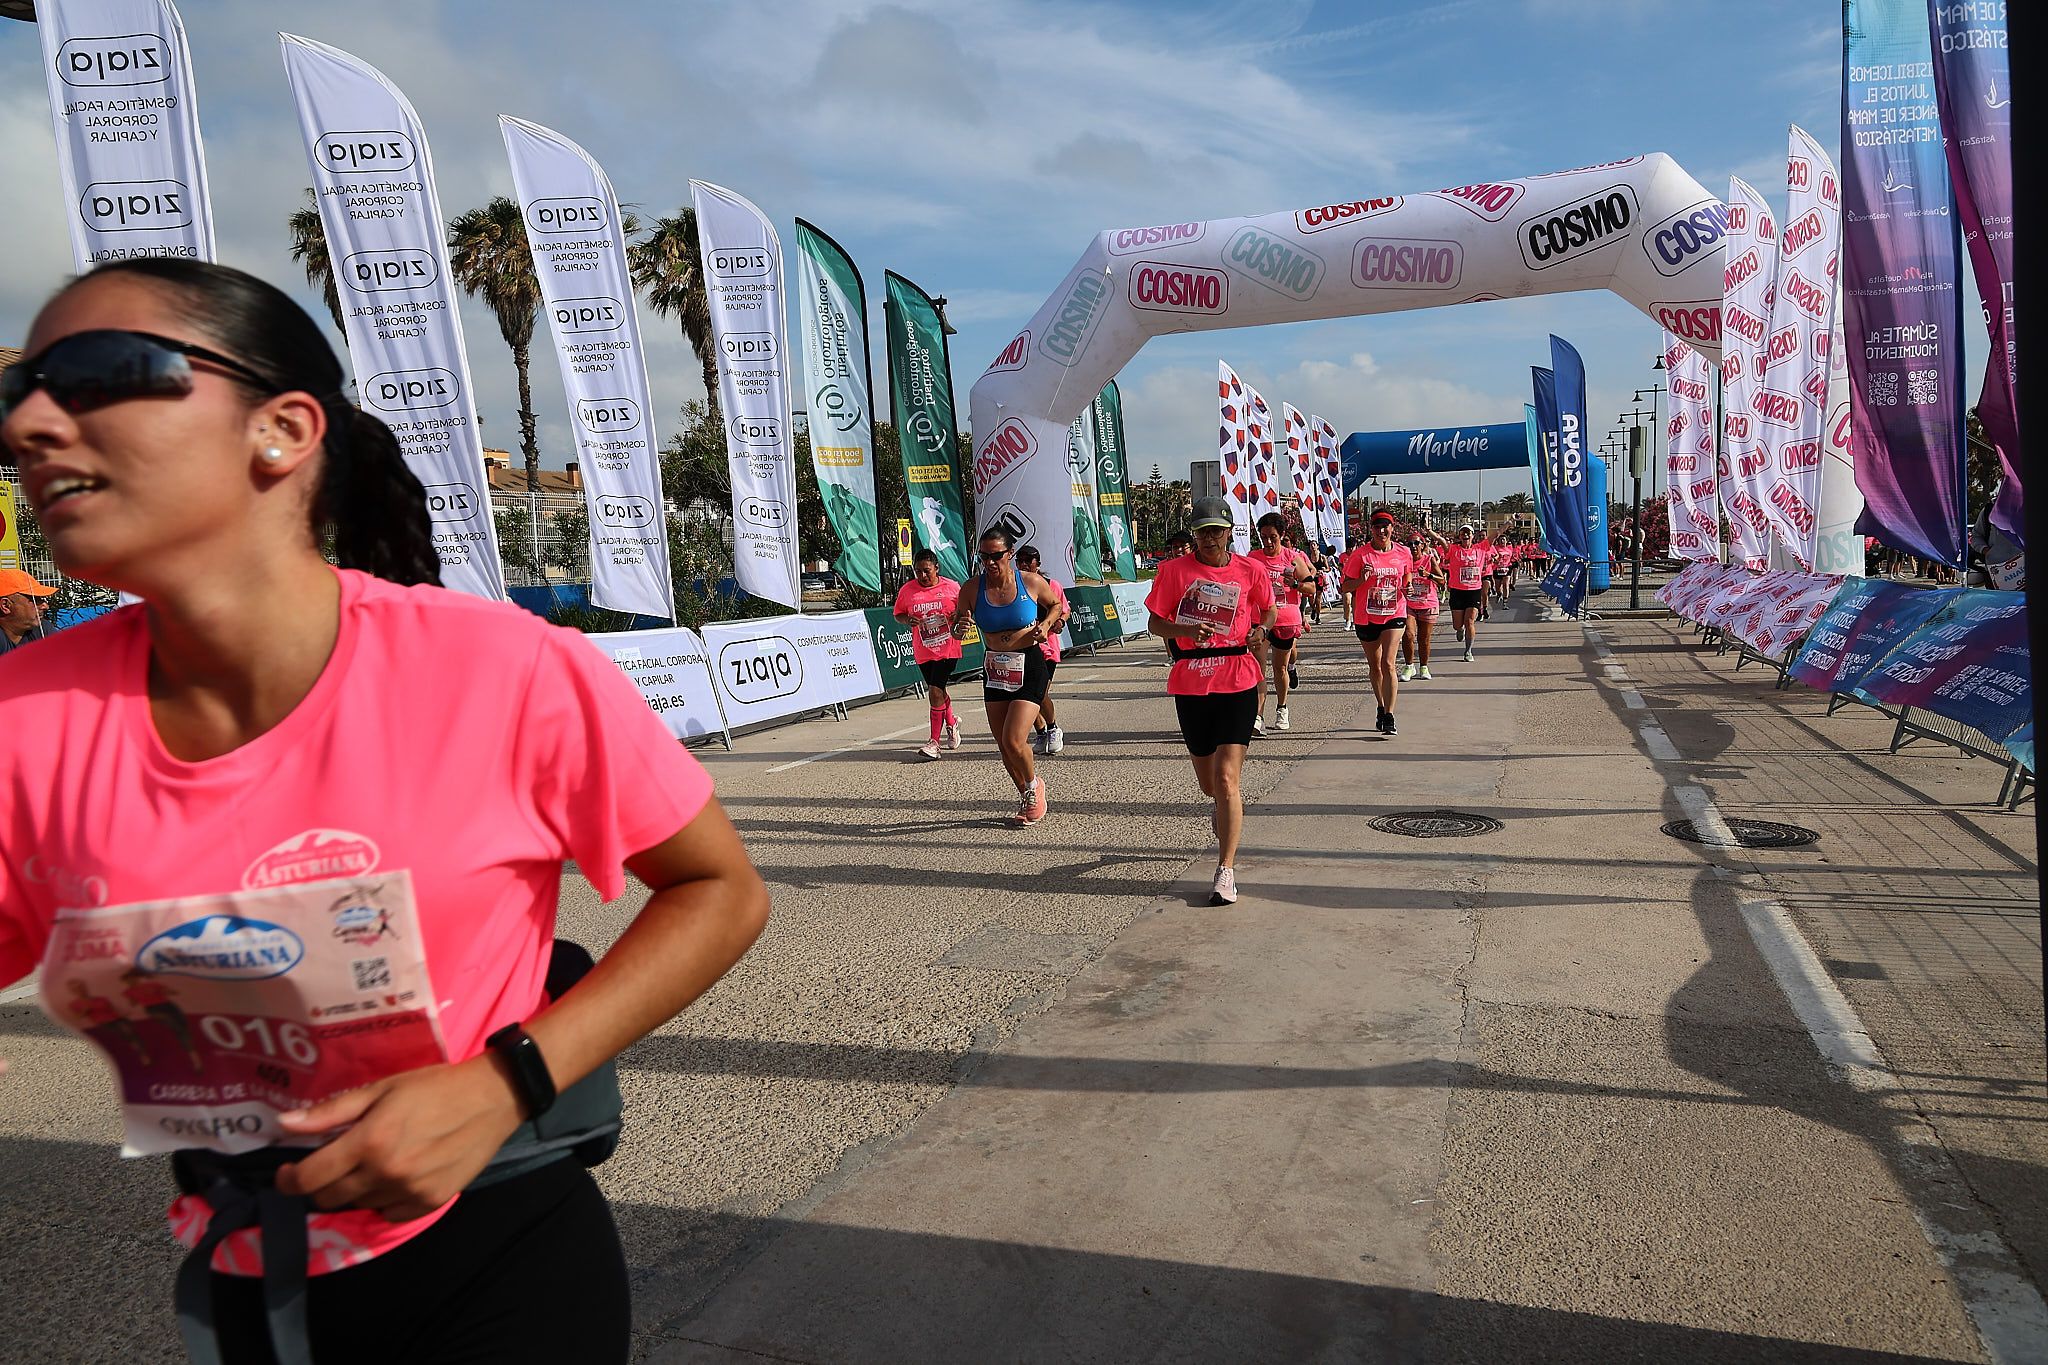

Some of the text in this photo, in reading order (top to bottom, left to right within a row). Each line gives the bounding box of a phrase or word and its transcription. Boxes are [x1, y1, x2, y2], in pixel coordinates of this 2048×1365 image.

[1116, 222, 1199, 249] COSMO
[1528, 192, 1631, 261] COSMO
[1655, 202, 1730, 266] COSM
[1231, 231, 1317, 294] COSMO
[1360, 244, 1454, 284] COSMO
[1137, 268, 1221, 309] COSMO
[1046, 276, 1106, 357] COSMO
[1659, 307, 1723, 341] COSM
[975, 426, 1029, 495] COSMO
[1408, 431, 1489, 466] Marlene
[913, 601, 943, 613] CARRERA
[1197, 602, 1218, 614] 016
[797, 634, 828, 648] COSMÉTICA
[843, 630, 868, 642] CORPORAL
[832, 646, 850, 656] CAPILAR
[637, 654, 704, 671] FACIAL, CORPORA
[730, 652, 793, 689] ziaja
[831, 663, 857, 678] ziaja.es
[635, 673, 675, 688] Y CAPILAR
[646, 693, 685, 714] iaja.es
[253, 852, 368, 889] ASTURIANA
[153, 945, 291, 969] ASTURIANA
[201, 1015, 318, 1065] 016
[221, 1082, 247, 1099] DE
